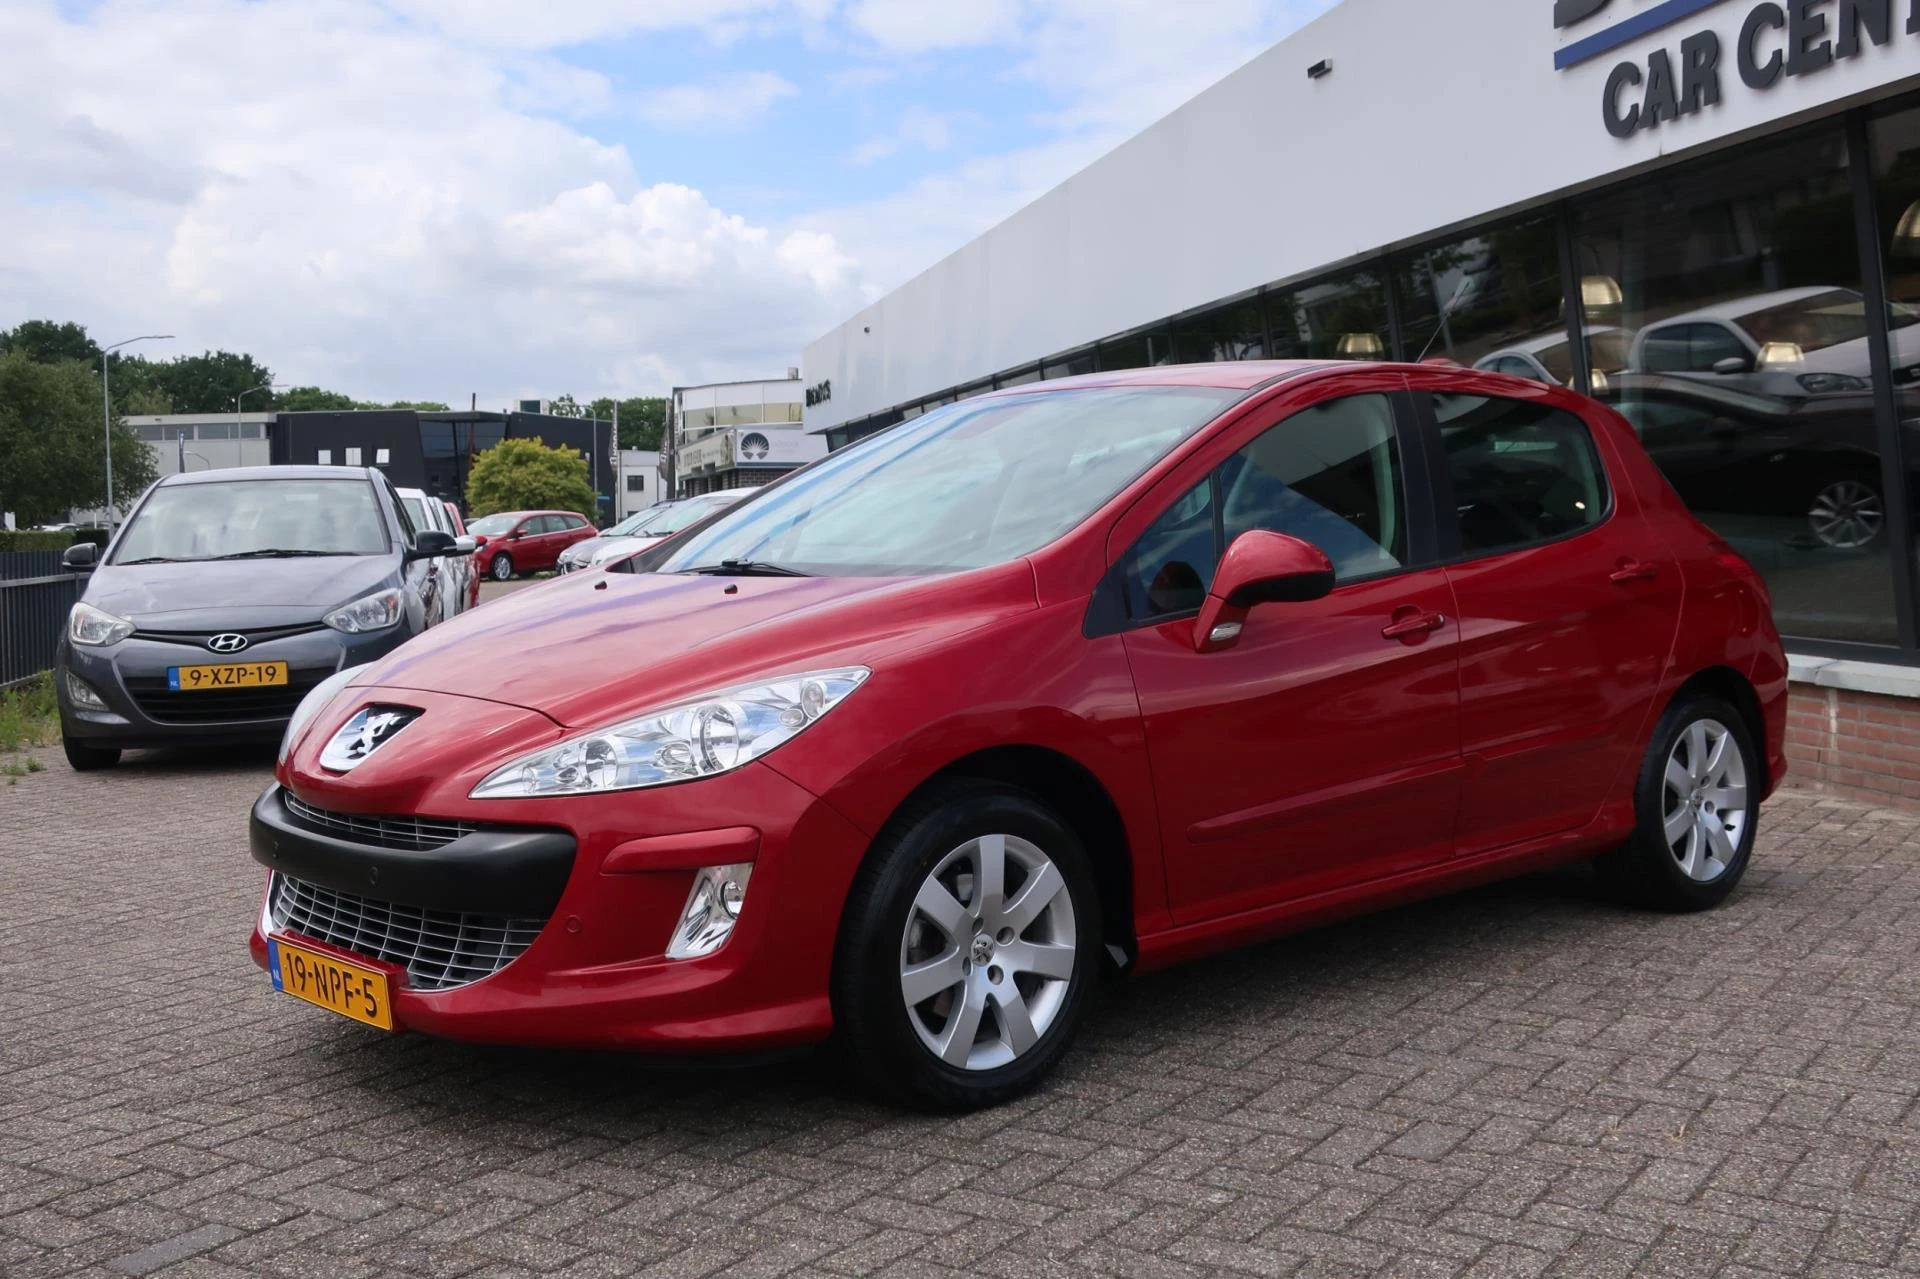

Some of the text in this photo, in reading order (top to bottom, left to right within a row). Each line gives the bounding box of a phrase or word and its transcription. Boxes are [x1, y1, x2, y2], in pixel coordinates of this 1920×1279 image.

[1602, 0, 1920, 138] CAR CEN
[189, 665, 277, 687] 9-XZP-19
[286, 951, 378, 1018] 19-NPF-5
